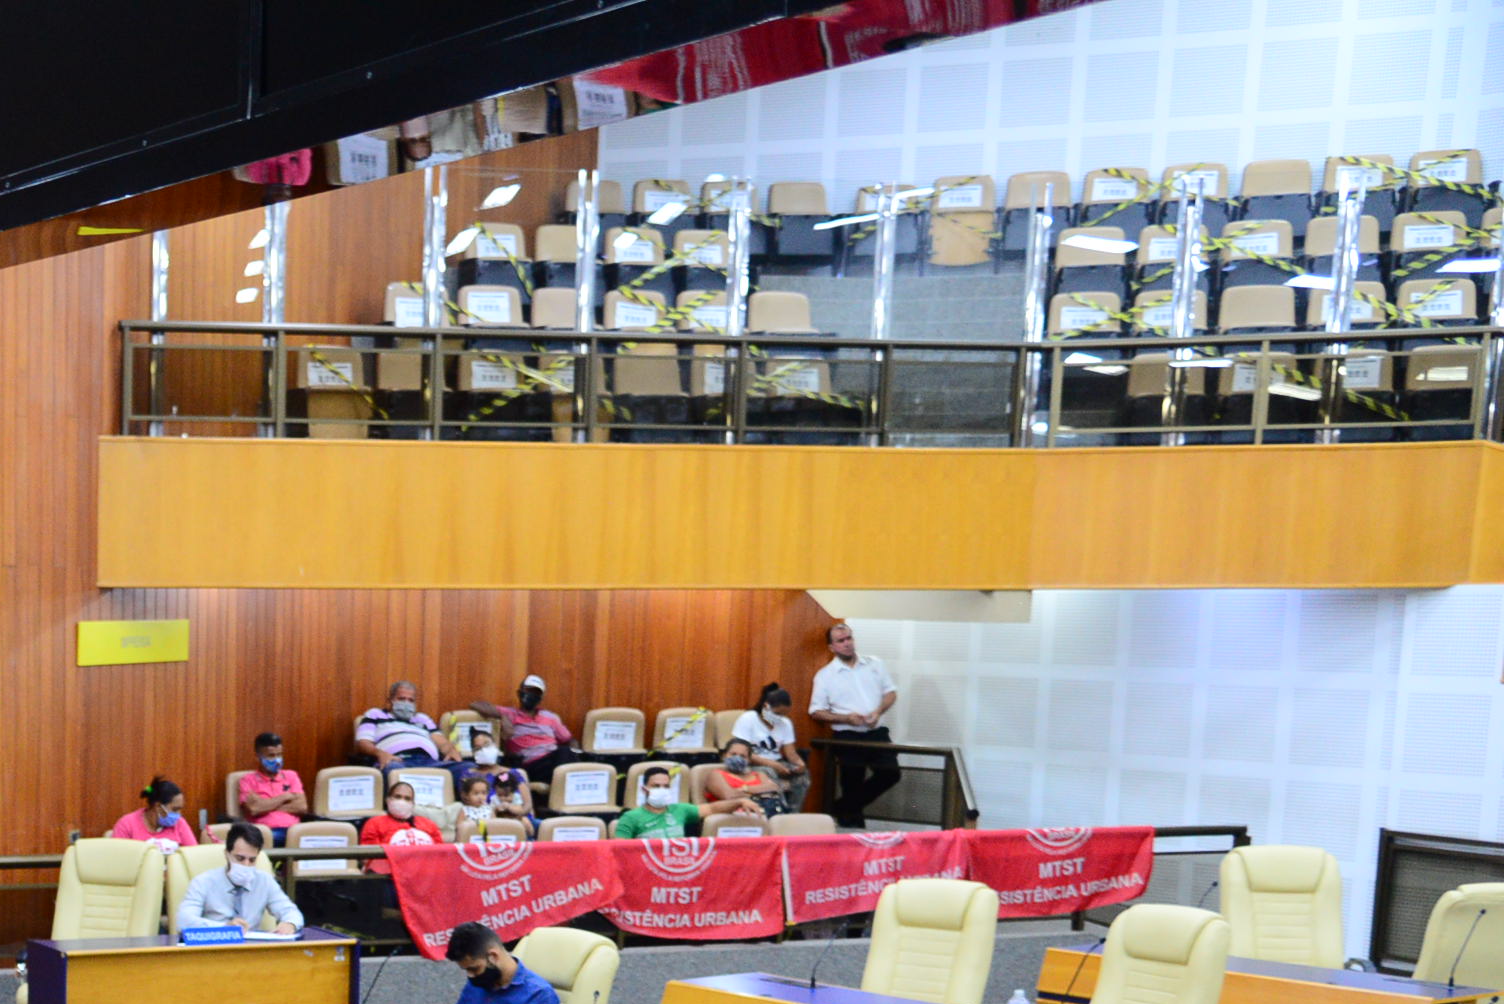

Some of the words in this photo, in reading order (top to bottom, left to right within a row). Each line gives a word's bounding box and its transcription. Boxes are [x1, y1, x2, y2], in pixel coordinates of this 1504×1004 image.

[863, 856, 906, 876] MTST
[1038, 858, 1085, 879] MTST
[480, 874, 532, 907] MTST
[531, 878, 604, 914] URBANA
[651, 886, 703, 904] MTST
[695, 909, 763, 927] URBANA
